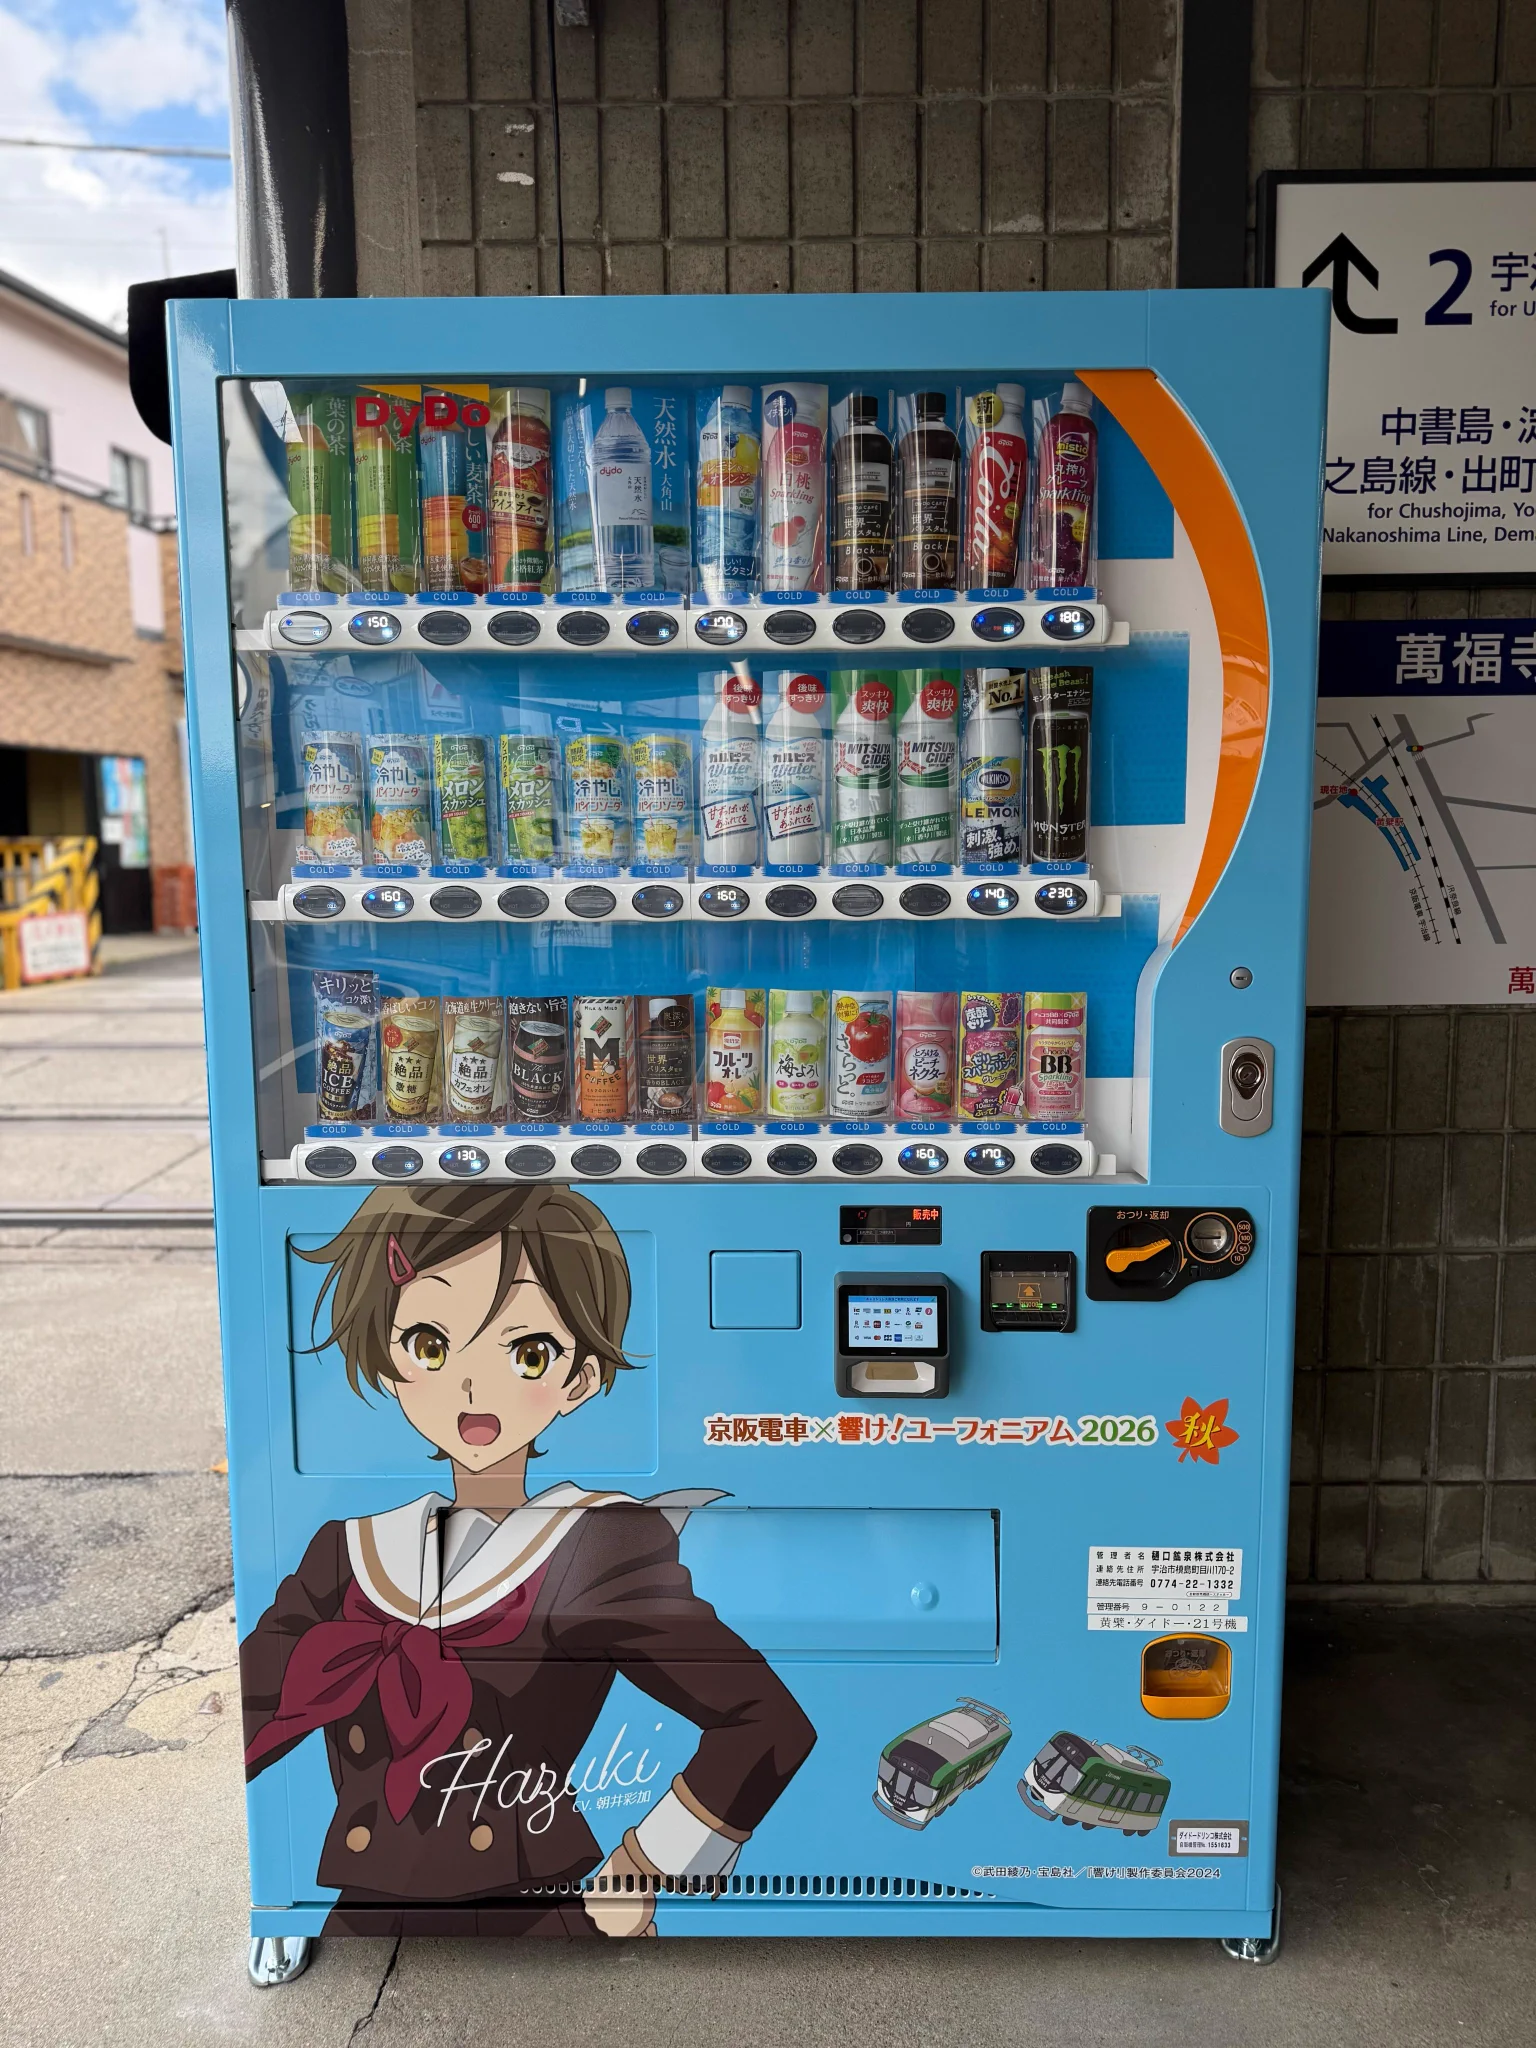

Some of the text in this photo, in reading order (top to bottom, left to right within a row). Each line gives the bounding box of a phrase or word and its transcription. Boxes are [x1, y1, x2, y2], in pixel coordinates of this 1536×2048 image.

[1491, 252, 1536, 292] 宇
[1425, 249, 1473, 326] 2
[1490, 300, 1517, 317] for
[356, 396, 490, 437] DyDo
[326, 397, 347, 456] 葉の茶
[653, 397, 677, 470] 天然水
[599, 466, 623, 477] dydo
[780, 471, 811, 490] 白桃
[769, 488, 815, 504] Sparkling
[1039, 486, 1091, 505] Sparkling
[1368, 503, 1393, 519] for
[1399, 503, 1506, 522] Chushojima,
[1323, 527, 1440, 543] Nakanoshima
[1448, 526, 1488, 545] Line,
[295, 593, 321, 601] COLD
[433, 593, 459, 601] COLD
[571, 593, 597, 601] COLD
[845, 592, 871, 600] COLD
[368, 616, 388, 628] 150
[1060, 611, 1081, 623] 180
[797, 683, 818, 693] 後味
[926, 688, 954, 697] スッキリ
[789, 694, 824, 703] すっきり!
[862, 690, 889, 699] スッキリ
[1032, 689, 1091, 703] モンスターエナジー
[860, 699, 889, 714] 爽快
[925, 698, 954, 712] 爽快
[847, 743, 891, 755] MITSUYA
[911, 742, 955, 753] MITSUYA
[709, 752, 752, 763] カルピス
[773, 752, 817, 763] カルピス
[861, 754, 891, 765] CIDER
[925, 753, 955, 763] CIDER
[309, 764, 349, 783] 冷やし
[708, 762, 752, 778] Water
[771, 762, 816, 778] Water
[376, 767, 417, 786] 冷やし
[980, 771, 1011, 786] WILKINSON
[309, 784, 353, 795] パインソーダ
[376, 787, 421, 798] パインソーダ
[442, 780, 486, 800] メロン
[508, 780, 551, 800] メロン
[575, 779, 620, 797] 冷やし
[639, 779, 684, 797] 冷やし
[442, 798, 486, 812] スカッシュ
[508, 798, 552, 812] スカッシュ
[575, 801, 623, 812] パインソーダ
[638, 800, 686, 812] パインソーダ
[965, 807, 1020, 818] LEMON
[715, 815, 748, 829] あふれてる
[779, 815, 812, 829] あふれてる
[1033, 819, 1086, 834] MONSTER
[377, 866, 403, 874] COLD
[512, 866, 537, 874] COLD
[646, 866, 671, 874] COLD
[778, 865, 804, 873] COLD
[912, 864, 937, 872] COLD
[1046, 863, 1072, 871] COLD
[381, 890, 401, 902] 160
[717, 890, 737, 901] 160
[985, 888, 1005, 899] 140
[1048, 887, 1073, 898] 230
[320, 976, 372, 994] キリッと
[382, 999, 436, 1015] 香ばしいコク
[509, 997, 568, 1015] 飽きない旨さ
[965, 1006, 989, 1020] 炭酸
[966, 1018, 991, 1030] ゼリー
[584, 1037, 621, 1071] M
[913, 1049, 940, 1058] とろける
[713, 1051, 753, 1069] フルーツ
[836, 1033, 857, 1098] さらっと。
[915, 1058, 940, 1068] ピーチ
[1040, 1054, 1073, 1074] BB
[327, 1060, 351, 1074] 絶品
[394, 1062, 423, 1079] 絶品
[458, 1062, 488, 1079] 絶品
[776, 1054, 820, 1079] 梅よろし
[963, 1055, 1017, 1078] スパークリング
[323, 1070, 353, 1088] ICE
[513, 1063, 563, 1084] BLACK
[584, 1073, 622, 1085] COFFEE
[909, 1067, 946, 1081] ネクター
[982, 1073, 1007, 1084] グレープ
[1038, 1073, 1074, 1083] Sparkling
[322, 1083, 351, 1095] COFFEE
[395, 1081, 417, 1094] 微糖
[454, 1078, 490, 1093] カフェオレ
[585, 1124, 610, 1132] COLD
[715, 1123, 740, 1131] COLD
[846, 1123, 870, 1131] COLD
[976, 1123, 1001, 1131] COLD
[457, 1150, 477, 1160] 130
[916, 1149, 936, 1159] 160
[982, 1149, 1002, 1159] 170
[912, 1208, 939, 1221] 販売中
[1116, 1210, 1170, 1220] おつり・返却
[1180, 1412, 1218, 1451] 秋
[1096, 1551, 1145, 1561] 管理者名
[1095, 1564, 1145, 1574] 連絡先住所
[1095, 1578, 1234, 1590] 連絡先電話番号 0774-22-1332
[1096, 1602, 1130, 1612] 管理番号
[419, 1722, 663, 1835] Hazuki
[572, 1790, 652, 1813] CV. 朝井彩加
